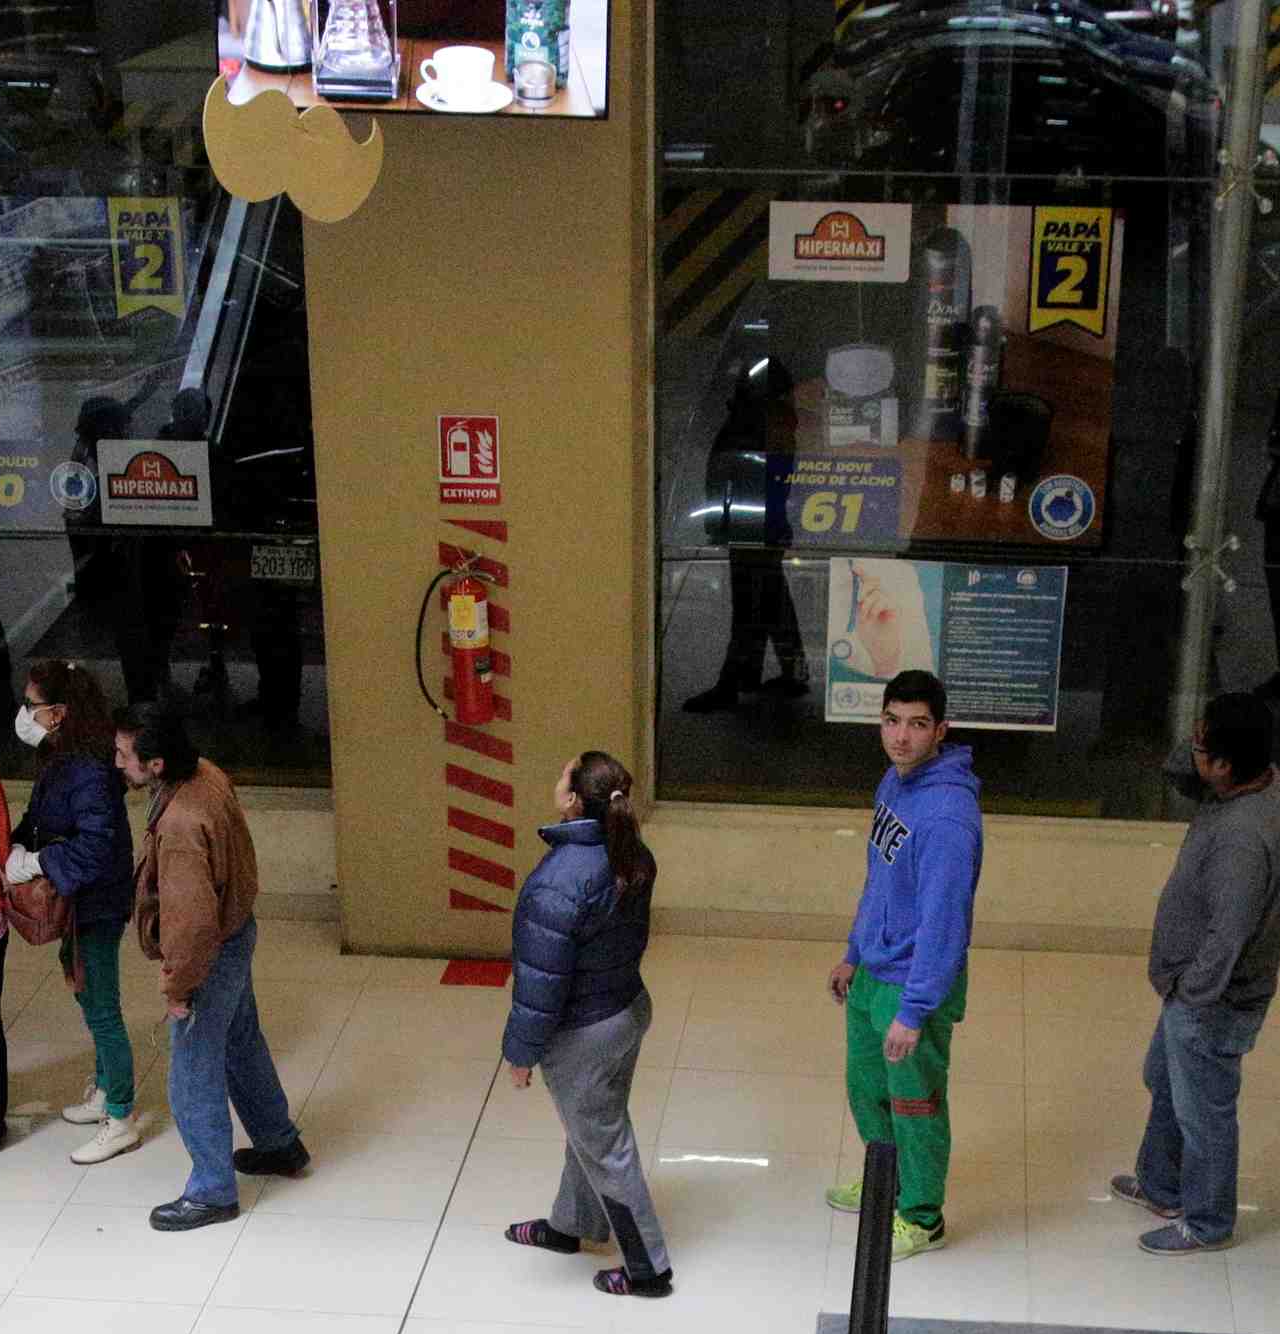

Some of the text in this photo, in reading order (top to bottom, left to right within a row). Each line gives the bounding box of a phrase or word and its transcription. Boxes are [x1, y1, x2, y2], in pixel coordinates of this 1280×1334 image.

[1043, 217, 1100, 237] PAPÁ
[799, 240, 881, 256] HIPERMAXI
[128, 243, 165, 289] 2
[1045, 255, 1088, 304] 2
[798, 460, 874, 473] PACK DOVE
[784, 472, 897, 487] JUEGO DE CACHO
[112, 480, 193, 496] HIPERMAXI
[442, 487, 497, 499] EXTINTOR
[801, 491, 864, 533] 61
